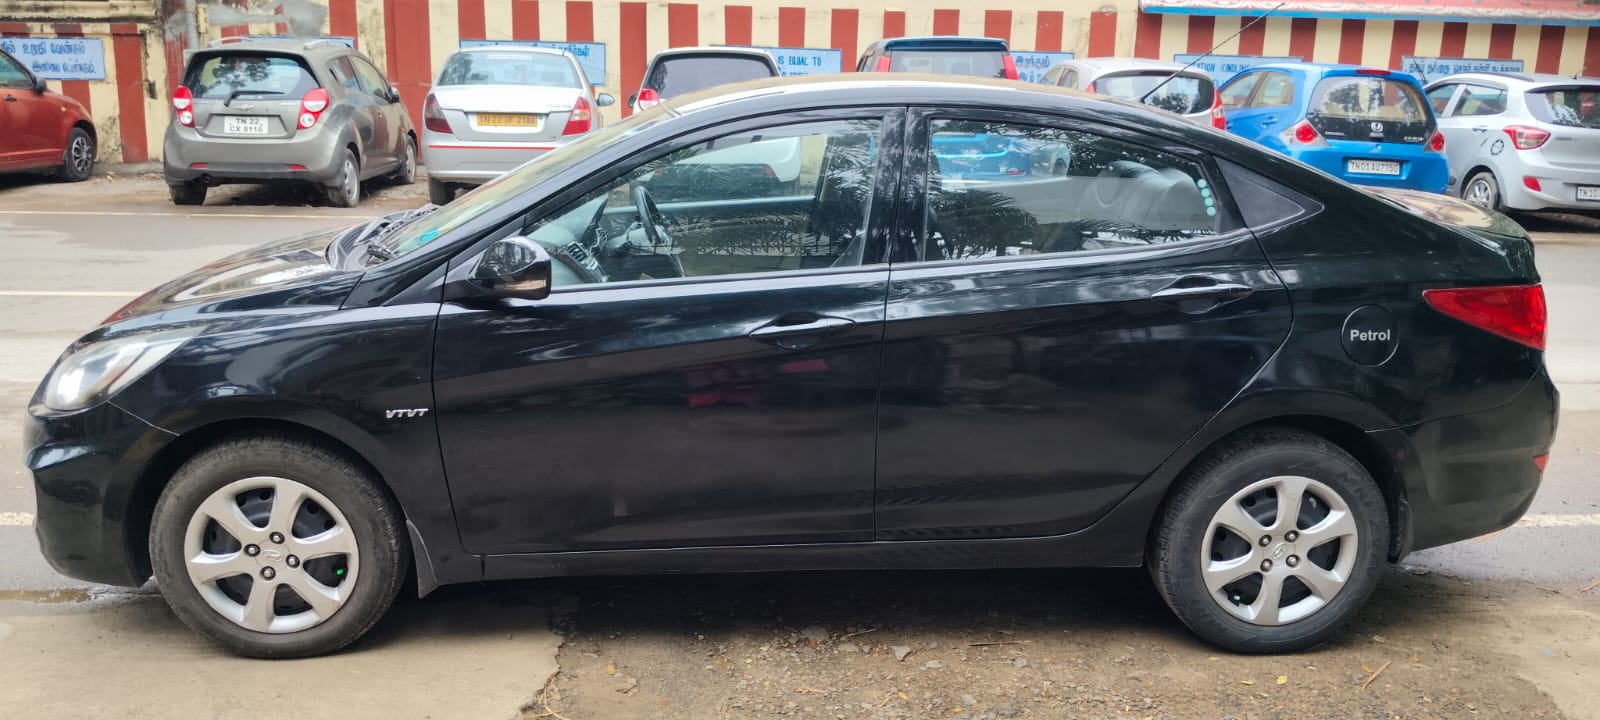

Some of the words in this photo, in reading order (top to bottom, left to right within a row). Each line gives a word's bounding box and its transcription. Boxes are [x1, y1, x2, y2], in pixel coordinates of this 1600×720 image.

[788, 56, 809, 66] EQUAL
[812, 57, 822, 66] TO
[1350, 329, 1391, 341] Petrol
[385, 408, 429, 418] VTVT
